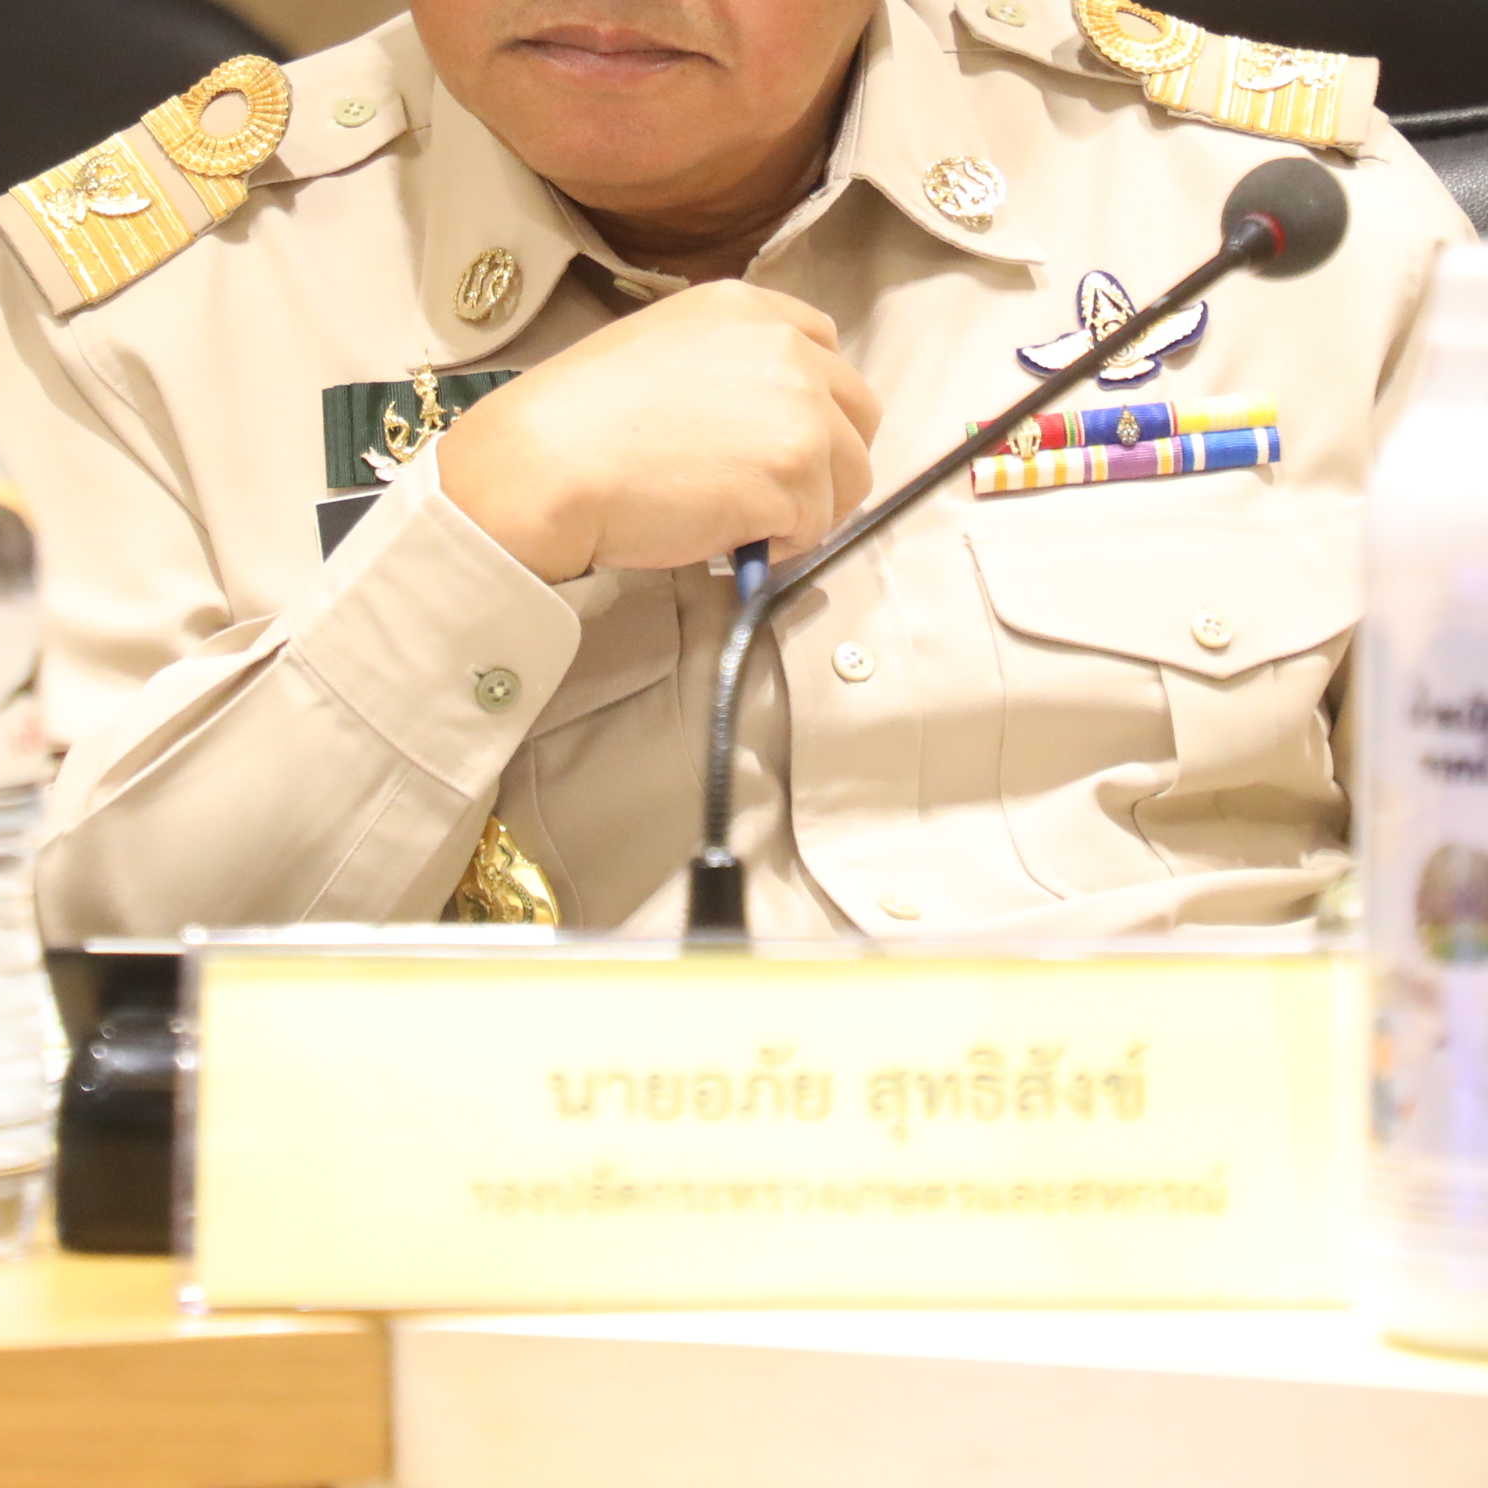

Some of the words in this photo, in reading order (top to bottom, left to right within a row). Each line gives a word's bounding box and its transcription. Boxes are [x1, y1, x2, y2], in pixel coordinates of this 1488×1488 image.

[550, 1045, 832, 1117] นายอภัย
[869, 1042, 1146, 1142] สุทธิสังข์
